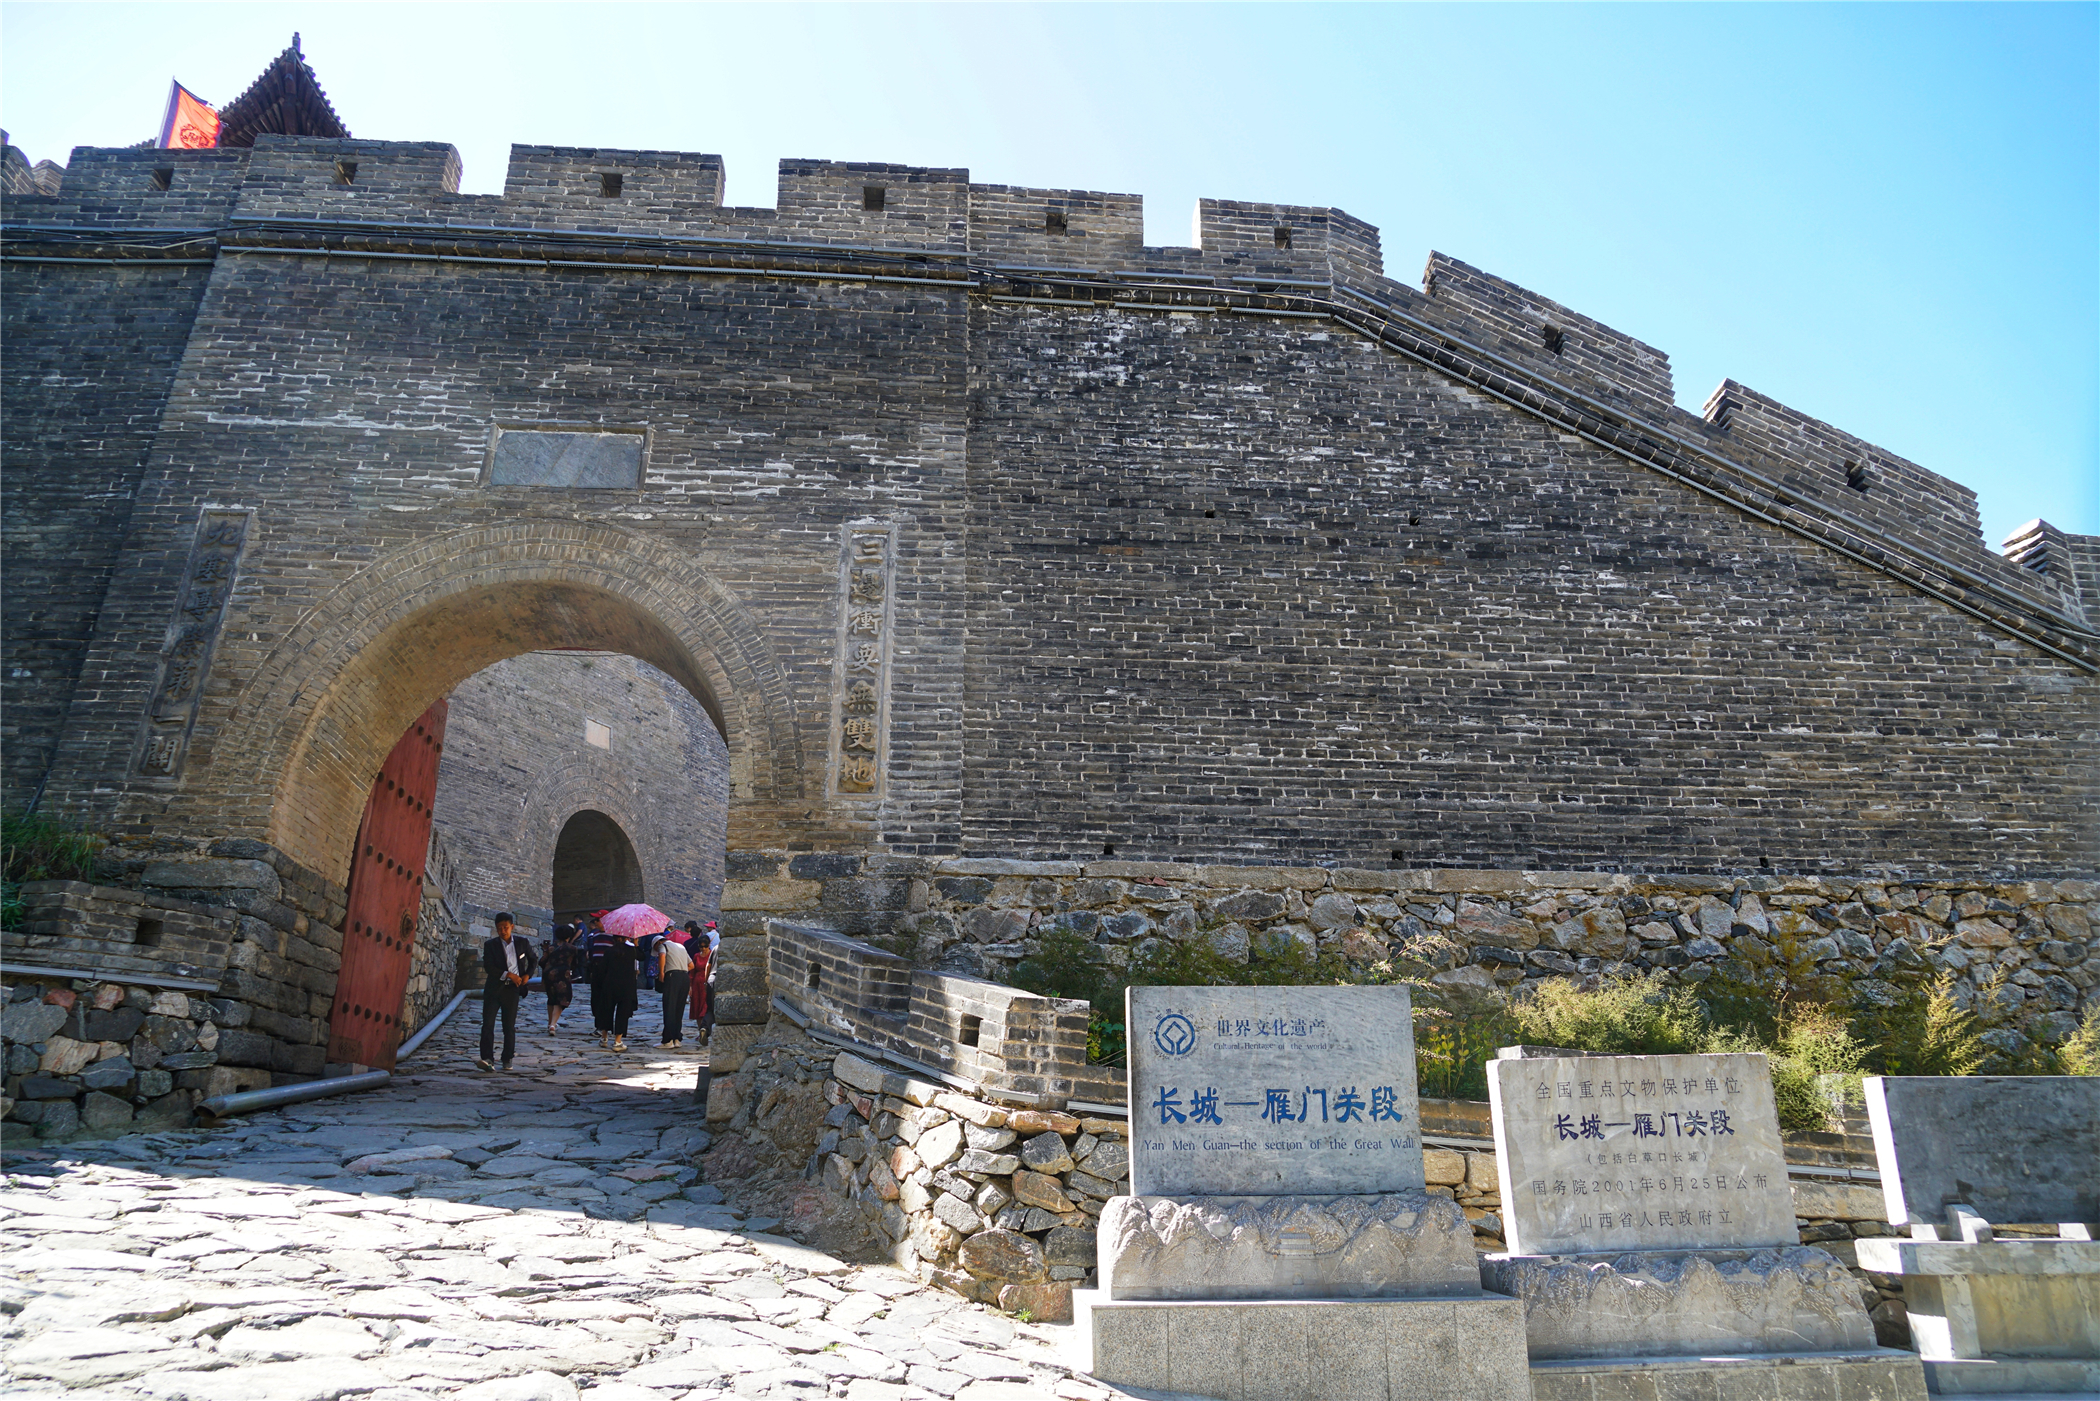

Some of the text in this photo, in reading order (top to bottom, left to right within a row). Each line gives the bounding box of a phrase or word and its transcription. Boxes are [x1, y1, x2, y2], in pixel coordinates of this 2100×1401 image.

[1217, 1018, 1326, 1038] 世界文化遗产
[1213, 1042, 1240, 1051] Cultural
[1244, 1042, 1273, 1052] Heritage
[1290, 1042, 1303, 1051] the
[1306, 1042, 1327, 1051] world
[1535, 1076, 1741, 1100] 全国重点文物保护单位
[1143, 1139, 1165, 1151] Yan
[1172, 1139, 1196, 1151] Men
[1264, 1139, 1303, 1150] section
[1309, 1138, 1322, 1150] of
[1329, 1138, 1347, 1150] the
[1354, 1138, 1382, 1150] Great
[1390, 1137, 1414, 1149] Wall
[1532, 1173, 1768, 1196] 国务院2001年6月25日公布
[1579, 1208, 1733, 1229] 山西省人民政府立
